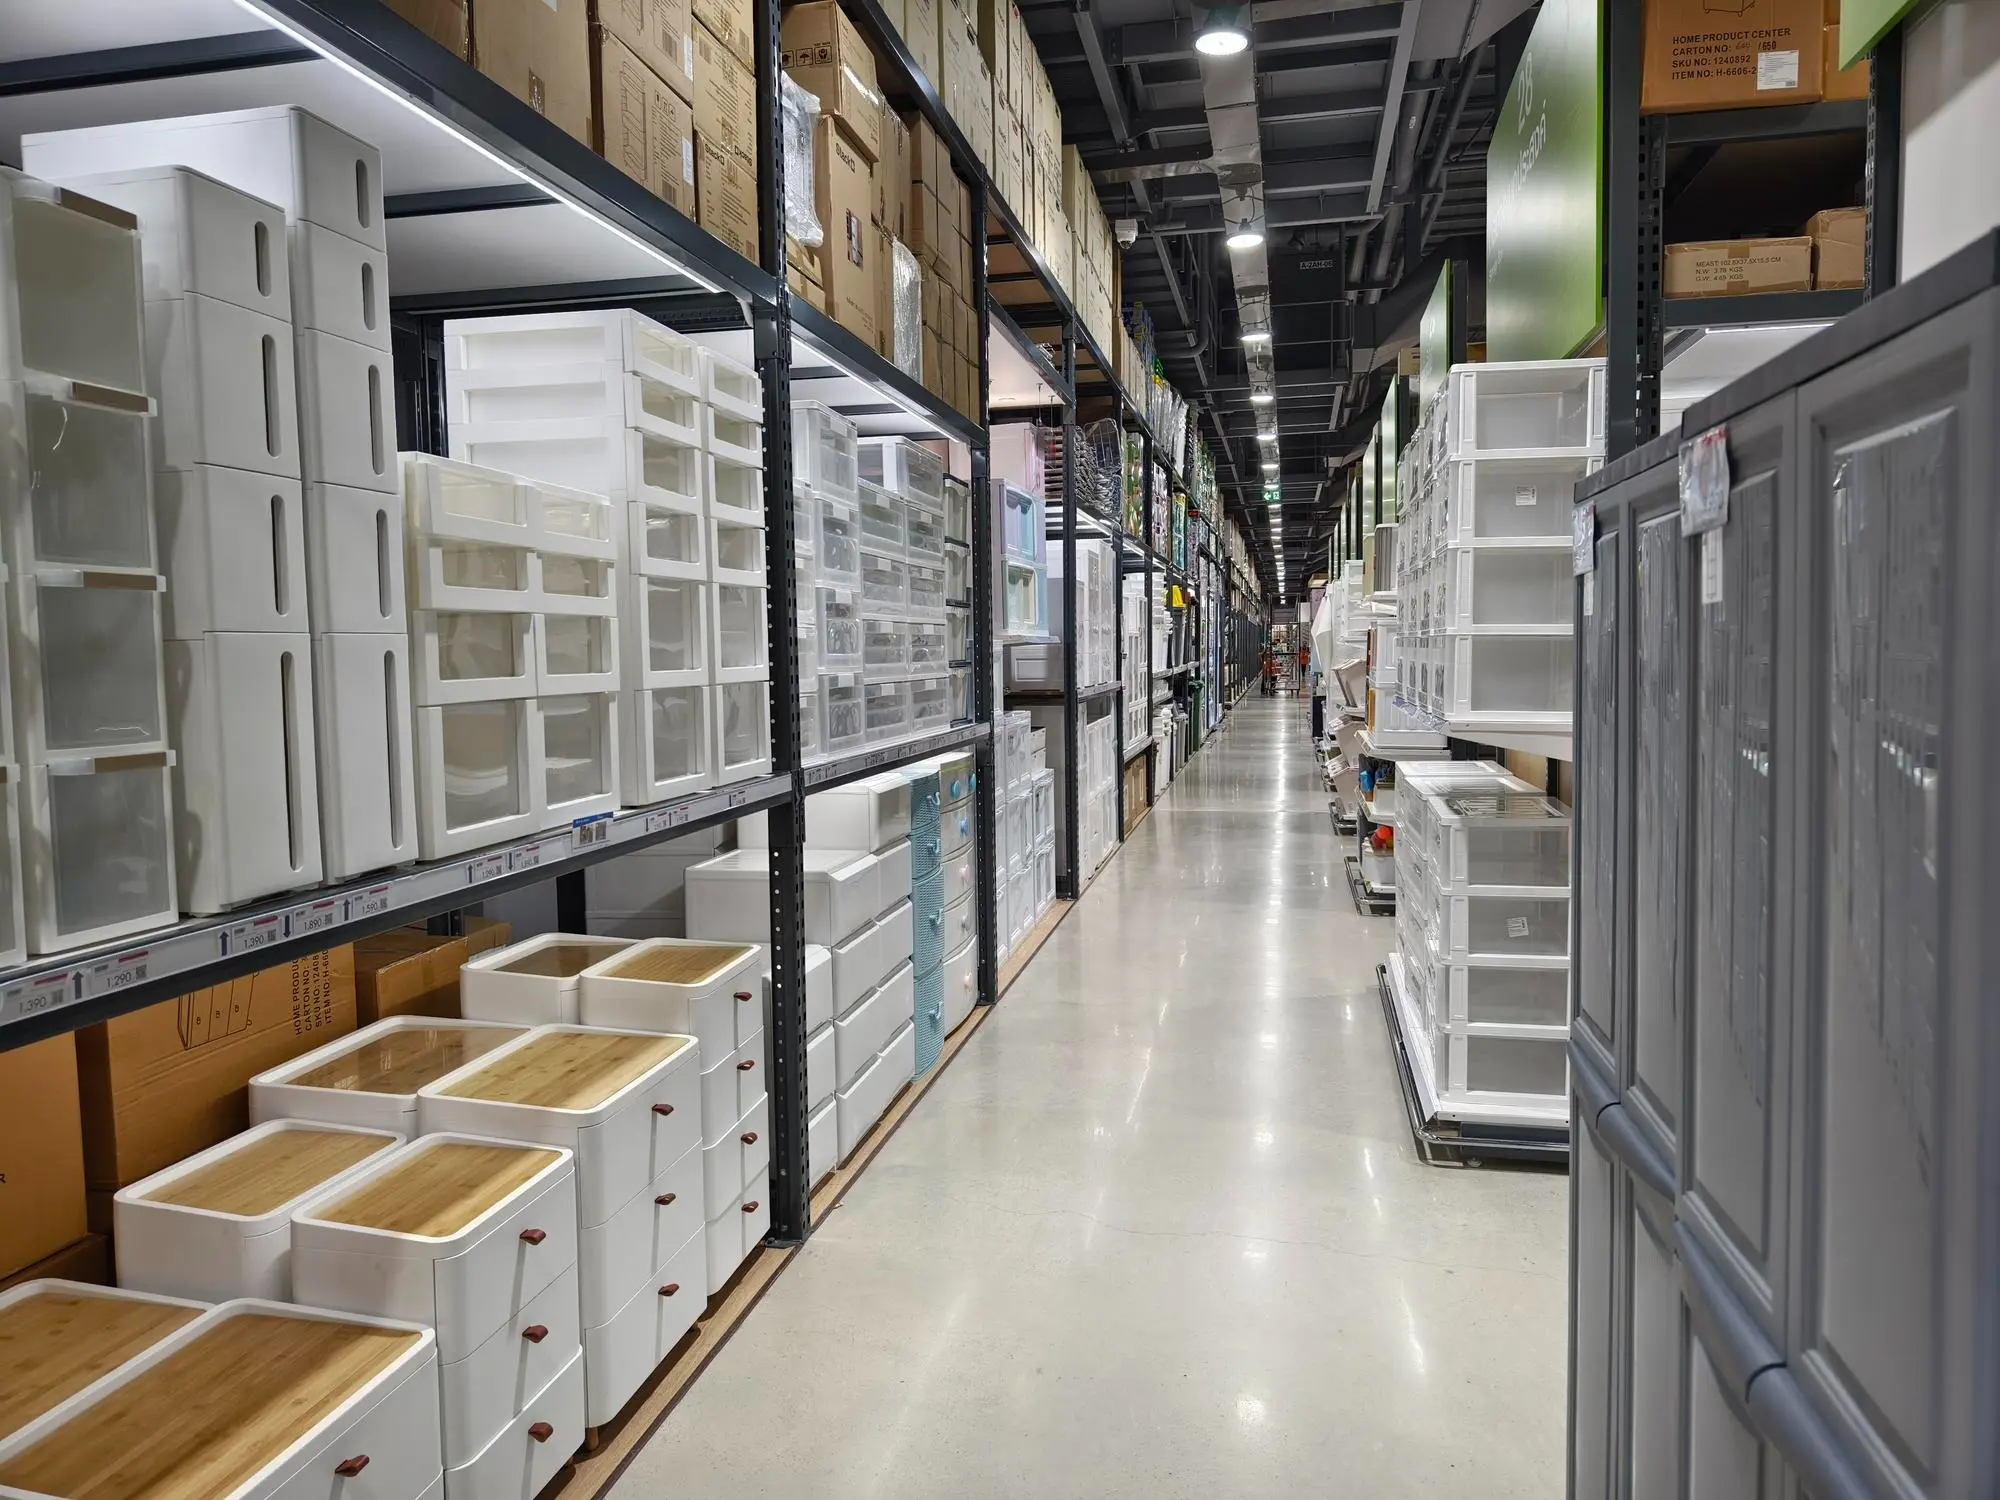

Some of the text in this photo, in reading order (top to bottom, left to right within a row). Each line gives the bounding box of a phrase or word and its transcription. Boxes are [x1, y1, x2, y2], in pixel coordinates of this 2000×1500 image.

[1672, 28, 1791, 44] HOME PRODUCT CENTER
[1672, 46, 1713, 56] CARTON
[1714, 44, 1732, 54] NO:
[1672, 54, 1751, 68] SKU NO: 1240892
[1672, 70, 1695, 80] ITEM
[1696, 68, 1714, 78] NO:
[1517, 51, 1533, 136] 28
[303, 987, 312, 1031] CARTON
[313, 1007, 322, 1027] SKU
[324, 1000, 332, 1024] ITEM
[293, 1004, 302, 1035] HOME
